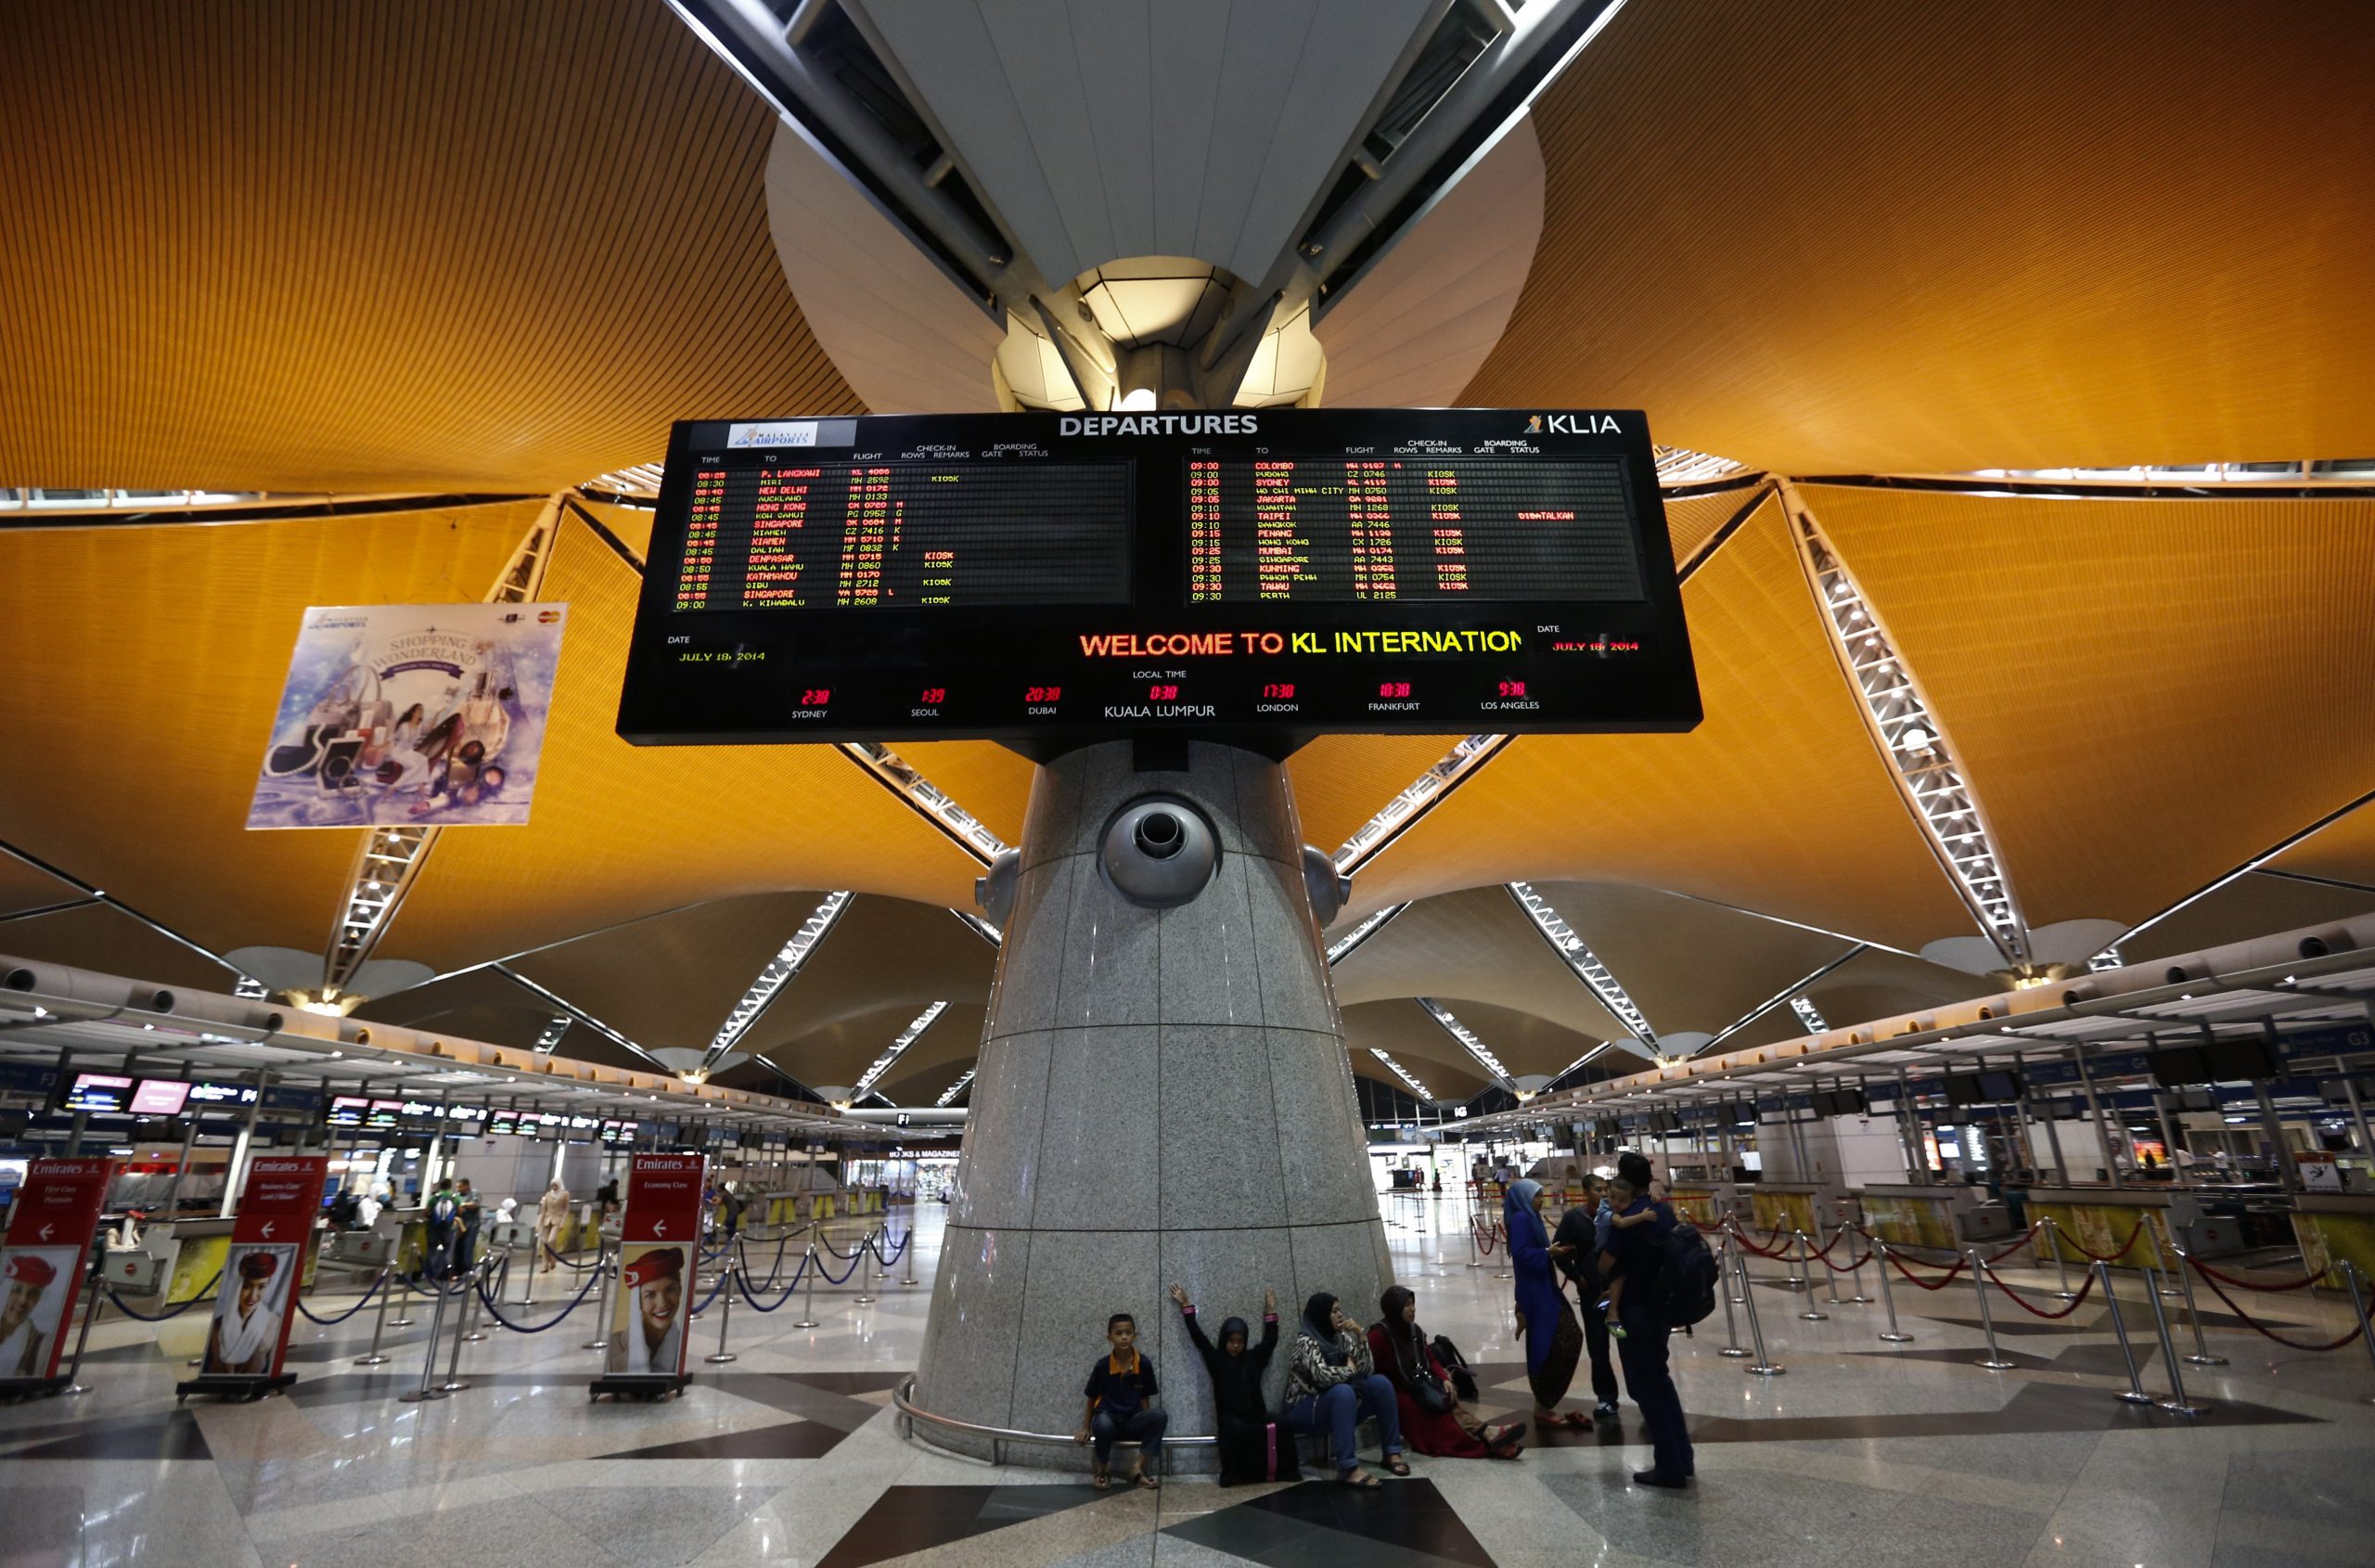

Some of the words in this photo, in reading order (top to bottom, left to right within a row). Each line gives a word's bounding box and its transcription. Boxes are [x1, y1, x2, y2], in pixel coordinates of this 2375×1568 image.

[1060, 415, 1258, 436] DEPARTURES
[1547, 416, 1622, 433] KLIA
[777, 469, 821, 478] LANGKAWI
[751, 537, 786, 546] XIAMEN
[749, 555, 794, 563] DENPASAR
[746, 572, 798, 581] KATHMANDU
[744, 590, 794, 598] SINGAPORE
[391, 635, 467, 651] SHOPPING
[1080, 633, 1233, 656] WELCOME
[1240, 633, 1283, 654] TO
[1292, 632, 1327, 653] KL
[1335, 631, 1521, 653] INTERNATION
[1553, 642, 1586, 651] JULY
[1610, 642, 1639, 650] 2014
[374, 649, 476, 667] WONDERLAND
[679, 653, 712, 662] JULY
[737, 652, 765, 661] 2014
[1133, 671, 1162, 679] LOCAL
[922, 688, 945, 703] 1:39
[1025, 688, 1061, 701] 20:38
[1149, 686, 1178, 700] 0:38
[1264, 684, 1294, 698] 17:38
[1380, 683, 1410, 697] 18:38
[1499, 682, 1525, 697] 9:38
[802, 689, 829, 704] 2:38
[1105, 706, 1151, 718] KUALA
[1157, 705, 1215, 717] LUMPUR
[1368, 702, 1420, 711] FRANKFURT
[2348, 1032, 2369, 1046] G3
[41, 1073, 58, 1086] F3
[32, 1163, 83, 1175] Emirates
[253, 1162, 298, 1172] Emirates
[636, 1159, 683, 1169] Emirates
